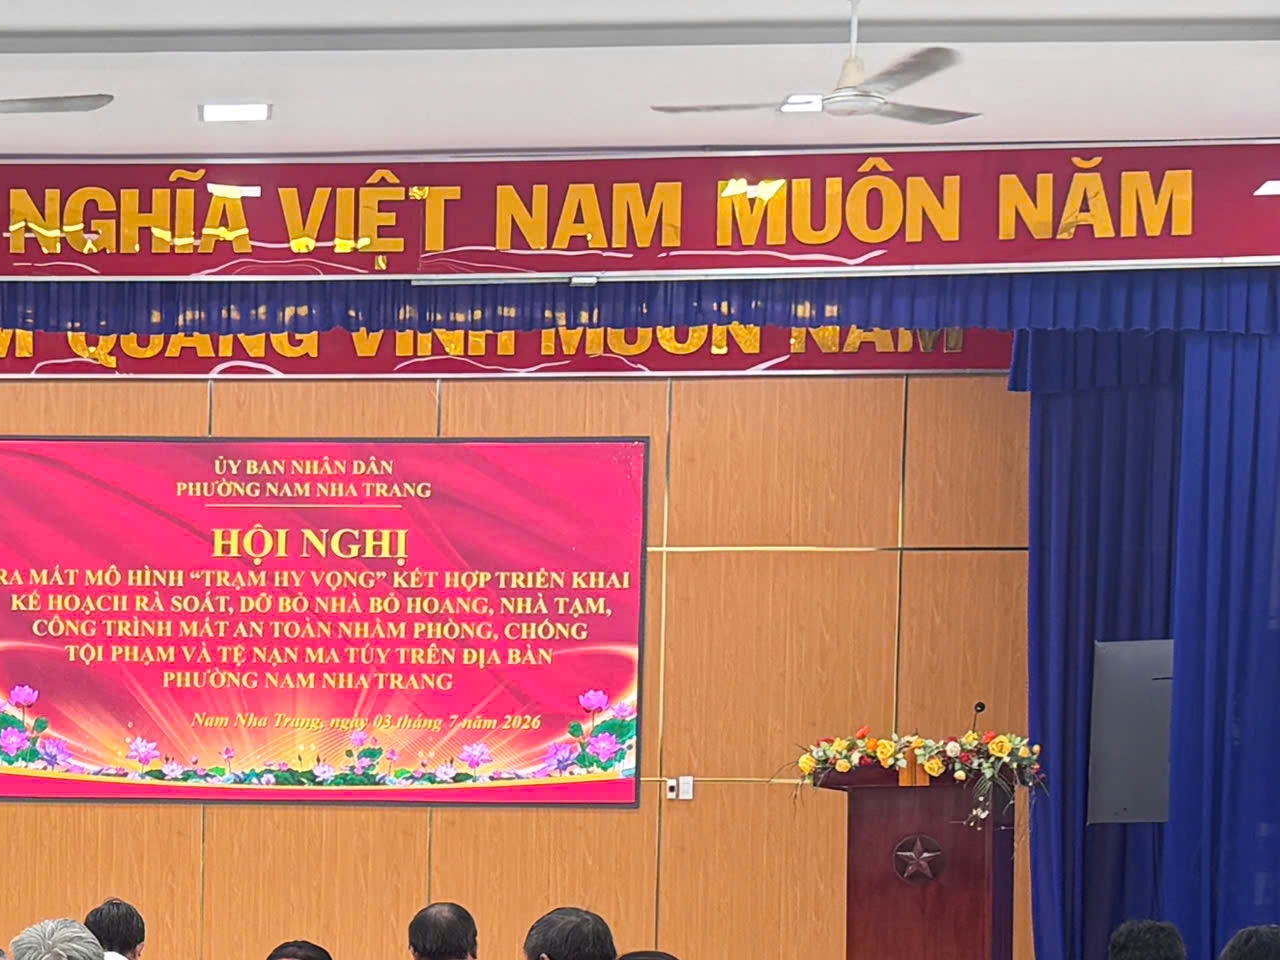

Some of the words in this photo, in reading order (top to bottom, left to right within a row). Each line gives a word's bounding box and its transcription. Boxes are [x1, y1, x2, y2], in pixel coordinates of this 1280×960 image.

[9, 168, 253, 255] NGHĨA
[278, 168, 462, 270] VIỆT
[496, 181, 683, 252] NAM
[716, 157, 961, 247] MUÔN
[998, 156, 1193, 240] NĂM
[246, 459, 285, 475] BAN
[291, 456, 347, 475] NHÂN
[352, 456, 394, 475] DÂN
[177, 480, 261, 498] PHƯỜNG
[266, 482, 310, 497] NAM
[316, 482, 358, 497] NHA
[362, 482, 432, 498] TRANG
[212, 523, 289, 566] HỘI
[301, 529, 408, 567] NGHỊ
[85, 564, 122, 587] MÔ
[128, 566, 184, 587] HÌNH
[274, 571, 306, 588] HY
[445, 569, 492, 592] HỢP
[572, 571, 630, 589] KHAI
[48, 594, 128, 617] HOẠCH
[134, 591, 165, 612] RÀ
[171, 591, 234, 615] SOÁT,
[278, 592, 309, 613] BỎ
[315, 592, 362, 614] NHÀ
[369, 592, 400, 614] BỎ
[407, 597, 494, 617] HOANG,
[500, 593, 549, 615] NHÀ
[554, 597, 612, 619] TẠM,
[32, 616, 96, 637] CÔNG
[102, 617, 172, 637] TRÌNH
[233, 621, 264, 638] AN
[270, 618, 331, 638] TOÀN
[413, 618, 499, 642] PHÒNG,
[64, 643, 103, 666] TỘI
[111, 645, 175, 667] PHẠM
[181, 642, 211, 662] VÀ
[218, 645, 245, 667] TỆ
[252, 646, 298, 667] NẠN
[305, 647, 340, 664] MA
[344, 644, 390, 665] TÚY
[397, 643, 456, 665] TRÊN
[462, 648, 501, 670] ĐỊA
[163, 668, 258, 689] PHƯỜNG
[265, 672, 315, 689] NAM
[322, 673, 369, 690] NHA
[374, 673, 453, 690] TRANG
[192, 713, 229, 728] Nam
[236, 713, 268, 728] Nha
[274, 713, 325, 732] Trang,
[330, 713, 368, 733] ngày
[373, 714, 392, 730] 03
[397, 714, 443, 733] tháng
[451, 715, 461, 730] 7
[462, 715, 497, 730] năm
[503, 715, 541, 731] 2026
